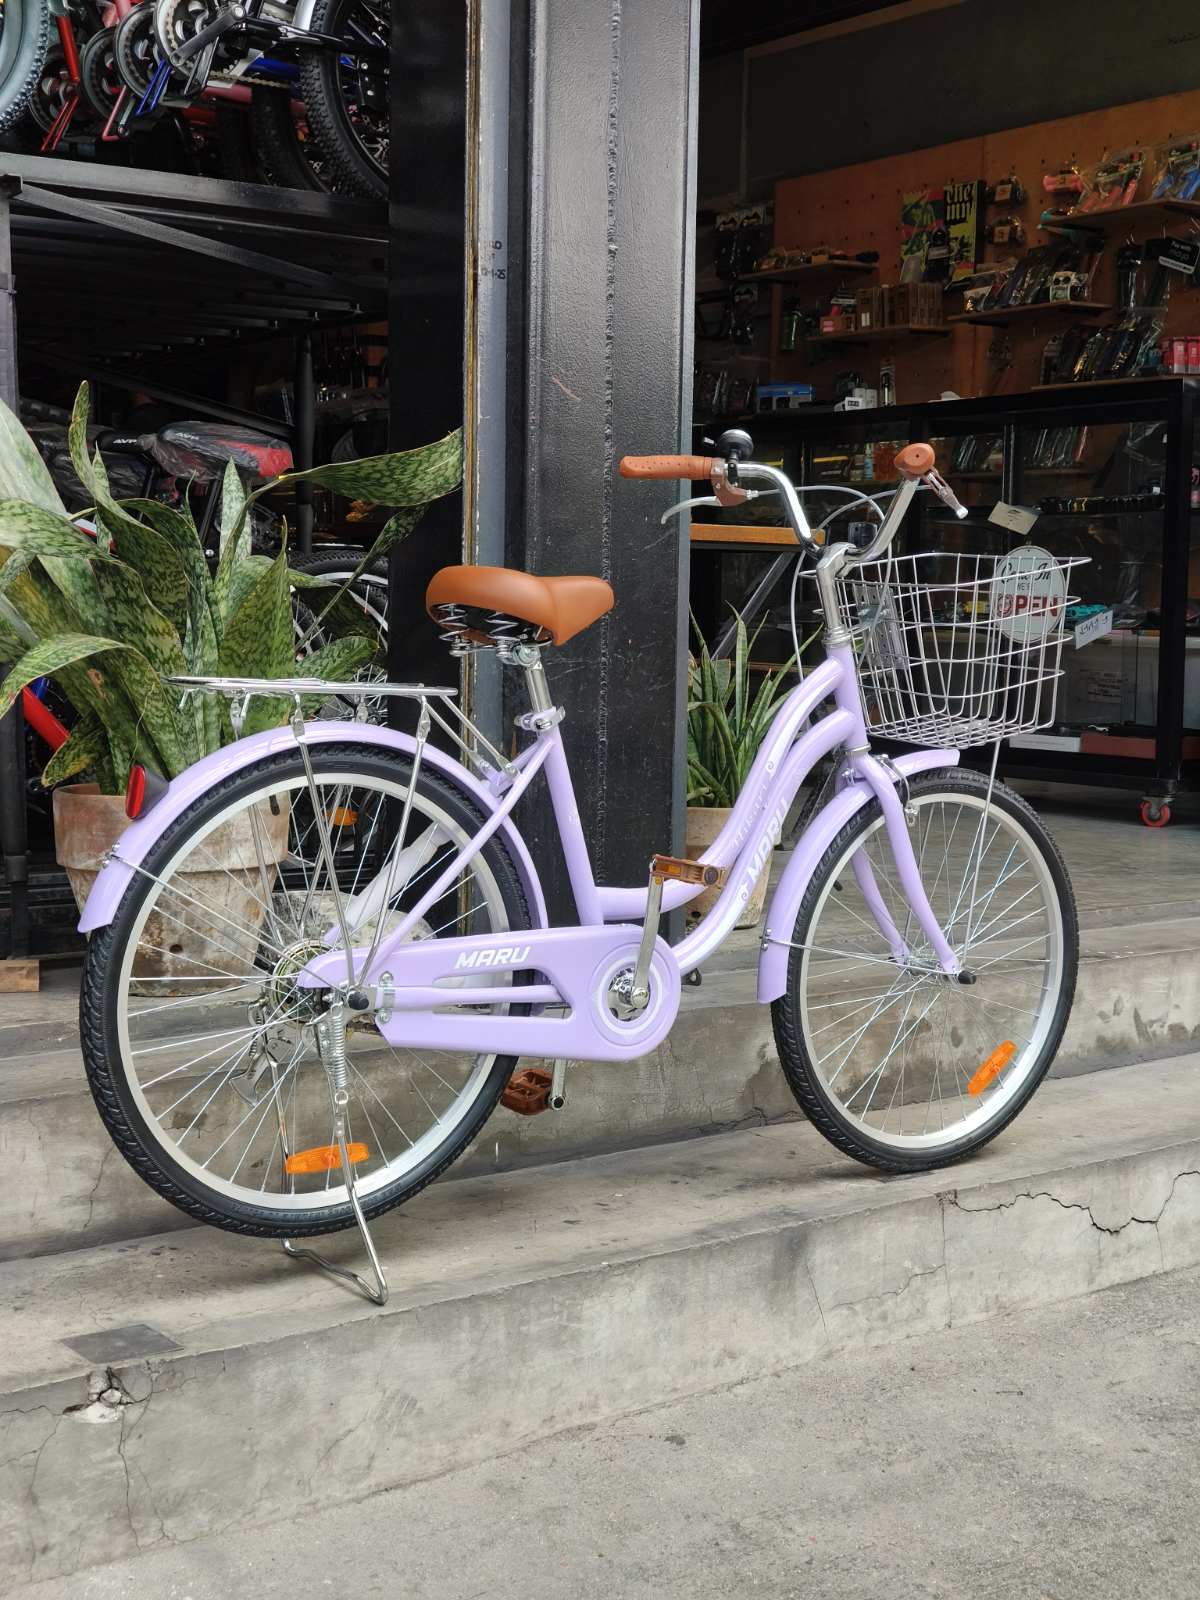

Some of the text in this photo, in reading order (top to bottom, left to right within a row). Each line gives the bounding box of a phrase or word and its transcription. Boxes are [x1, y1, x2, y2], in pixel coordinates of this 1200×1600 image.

[1034, 562, 1051, 581] In
[996, 593, 1059, 617] OPEN
[453, 945, 532, 969] MARU
